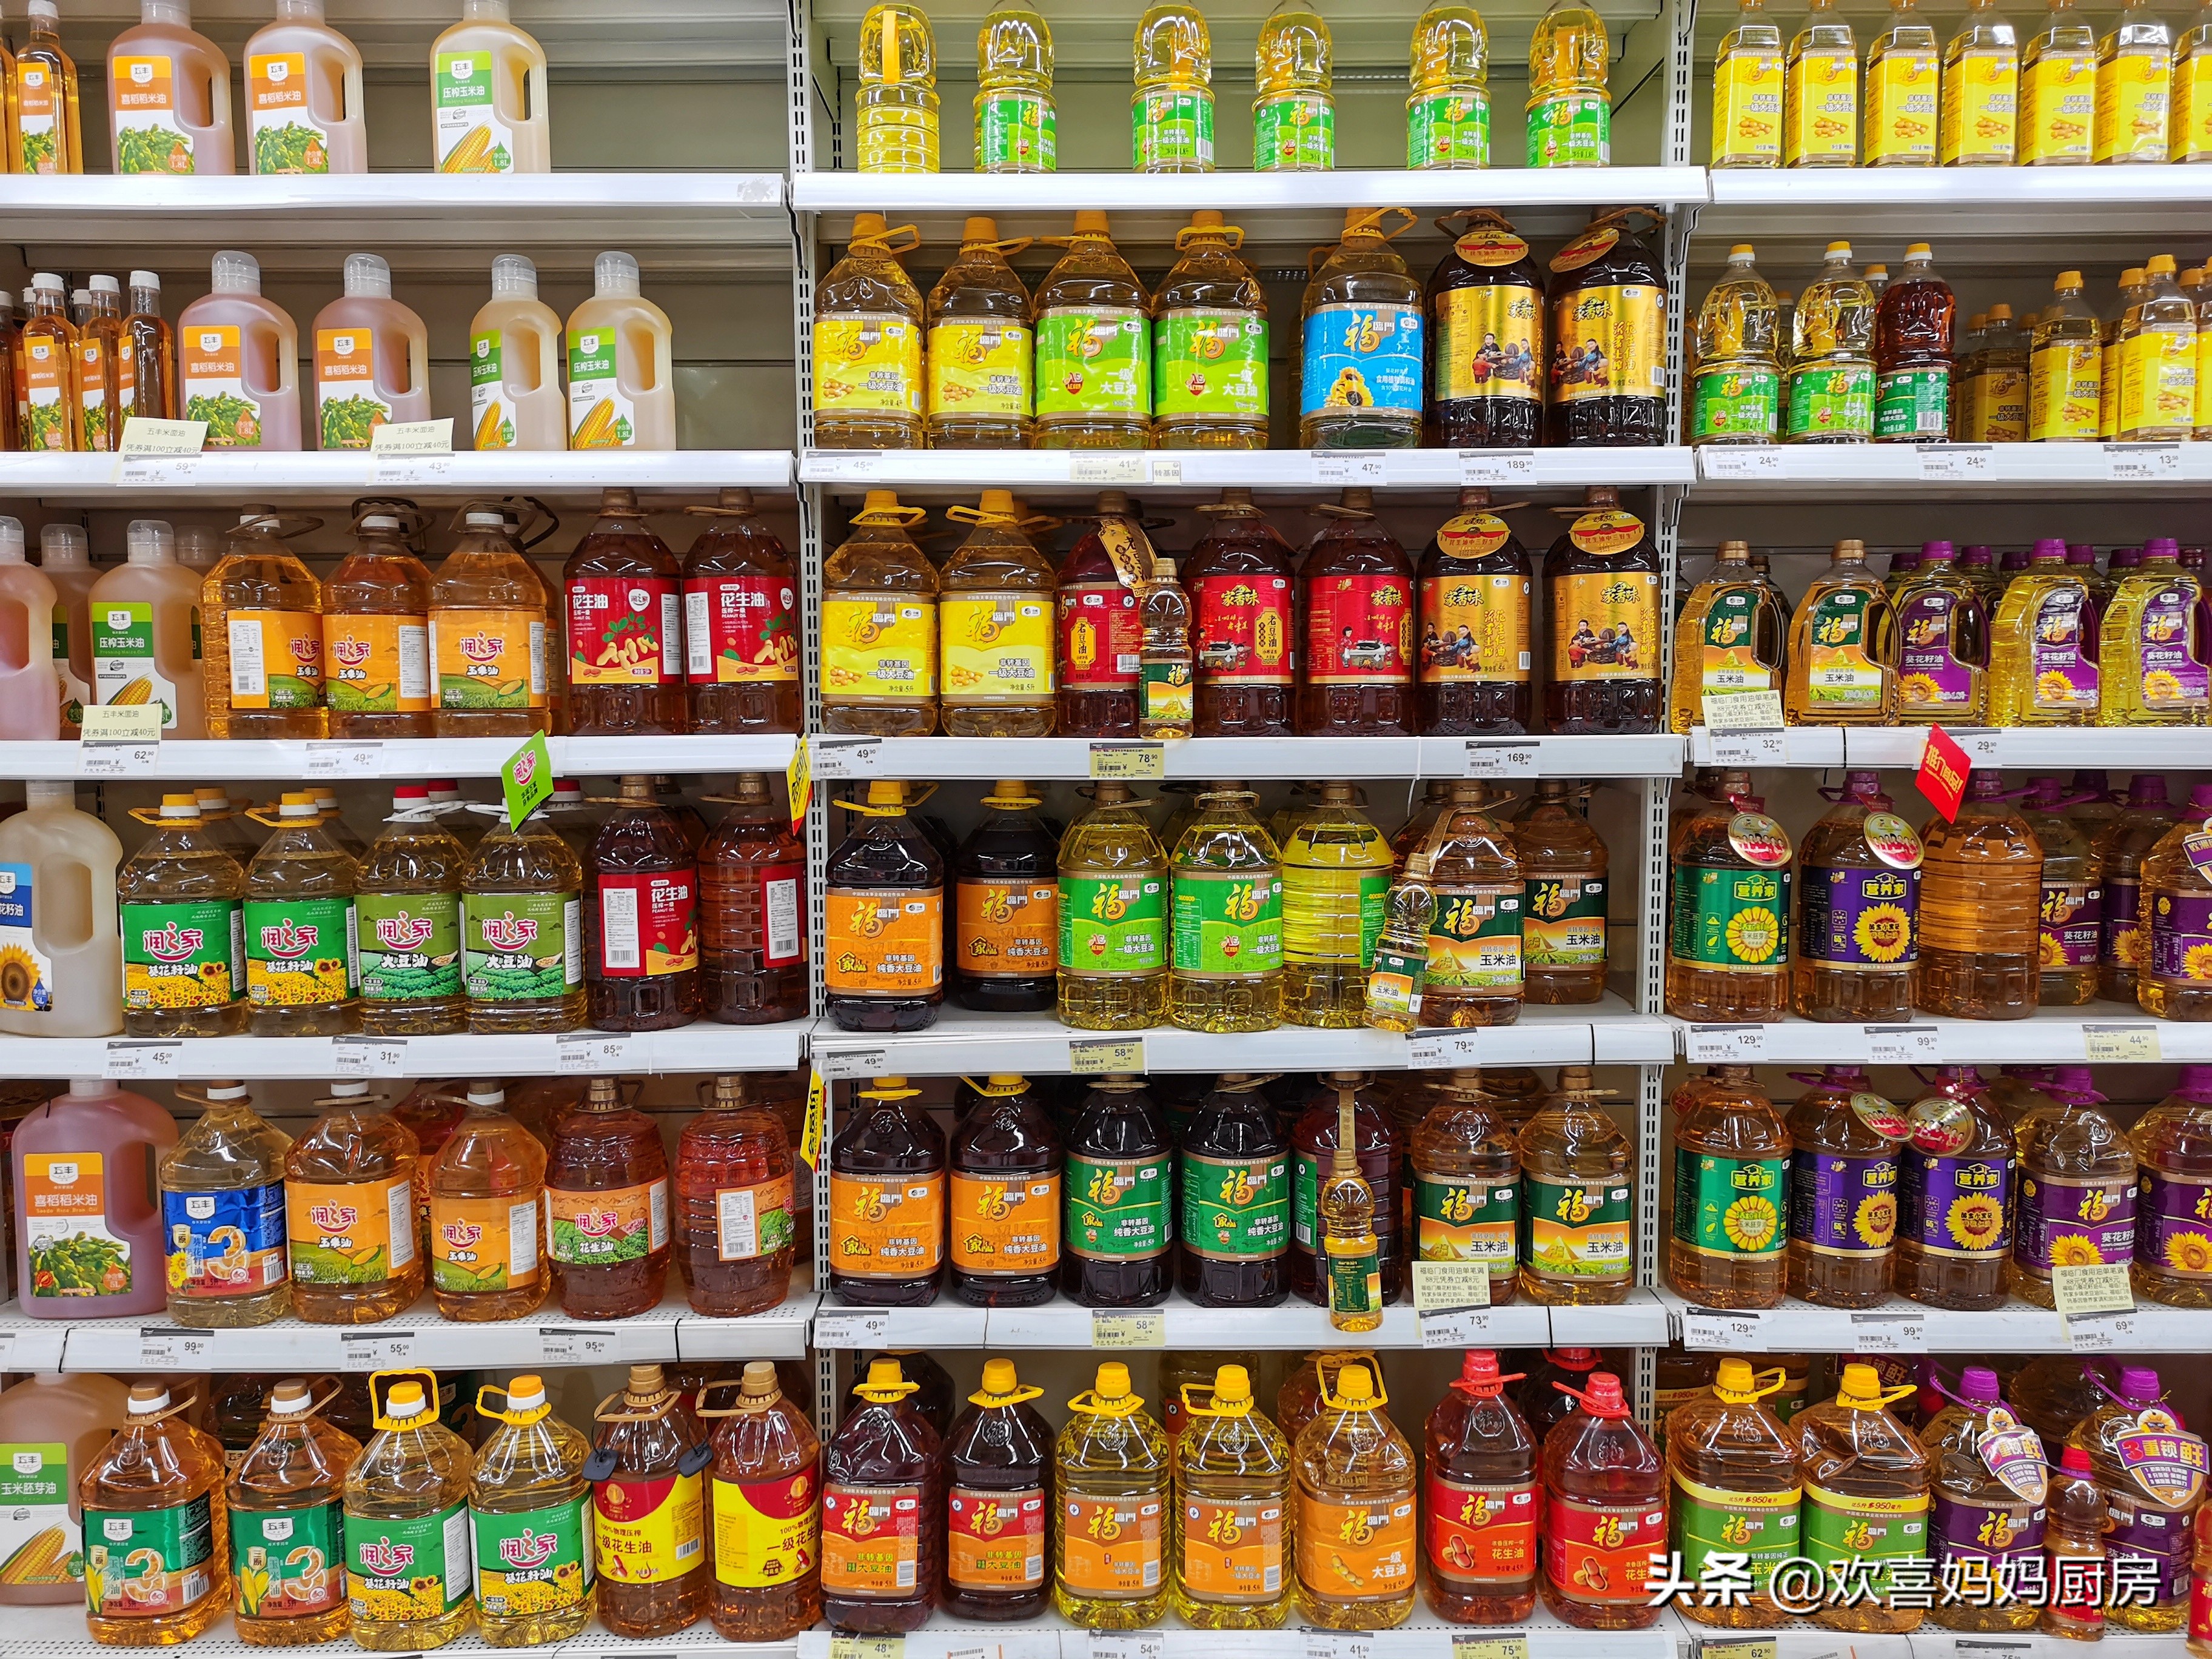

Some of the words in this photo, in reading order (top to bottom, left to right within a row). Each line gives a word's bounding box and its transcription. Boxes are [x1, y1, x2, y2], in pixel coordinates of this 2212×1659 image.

[258, 90, 301, 104] 喜稻稻米油
[443, 85, 485, 98] 压榨玉米油
[120, 93, 167, 108] 喜稻稻米油
[190, 361, 235, 374] 喜稻稻米油
[324, 364, 368, 376] 喜稻稻米油
[574, 360, 610, 374] 压榨玉米油
[869, 371, 899, 380] 非转基因
[989, 375, 1018, 384] 非转基因
[858, 380, 903, 392] 一级大豆油
[980, 383, 1022, 395] 一级大豆油
[1100, 381, 1138, 395] 大豆油
[1222, 383, 1258, 397] 大豆油
[147, 427, 185, 437] 五丰米面油
[238, 427, 255, 435] 1.8L
[396, 426, 435, 435] 五丰米面油
[126, 443, 201, 455] 凭券满100立减40元
[375, 440, 450, 452] 凭券满100立减40元
[1506, 460, 1532, 469] 189.90
[1966, 456, 1986, 464] 24.90
[2159, 455, 2179, 464] 13.50
[572, 593, 609, 610] 花生油
[720, 592, 766, 607] 花生油
[1267, 615, 1278, 648] 老豆油
[99, 637, 145, 649] 压榨玉米油
[1076, 623, 1088, 655] 老豆油
[1905, 654, 1943, 665] 葵花籽油
[2041, 651, 2076, 662] 葵花籽油
[2147, 651, 2183, 661] 葵花籽油
[877, 659, 910, 668] 非转基因
[998, 659, 1030, 668] 非转基因
[338, 668, 367, 680] 玉米油
[466, 665, 500, 677] 玉米油
[867, 669, 914, 680] 一级大豆油
[988, 668, 1036, 679] 一级大豆油
[1716, 673, 1744, 683] 玉米油
[1825, 672, 1854, 683] 玉米油
[102, 709, 139, 719] 五丰米面油
[82, 728, 156, 737] 凭券满100立减40元
[1763, 739, 1782, 748] 32.90
[1977, 742, 1997, 750] 29.90
[135, 751, 154, 759] 62.90
[857, 749, 876, 758] 49.90
[1138, 754, 1158, 762] 78.90
[1507, 754, 1532, 762] 169.90
[650, 885, 688, 902] 花生油
[1737, 884, 1775, 899] 营养家
[1865, 882, 1905, 896] 营养家
[377, 910, 433, 941] 润之家
[482, 910, 538, 941] 润之家
[1124, 934, 1153, 943] 非转基因
[1566, 933, 1601, 946] 玉米油
[2063, 930, 2097, 940] 葵花籽油
[1006, 946, 1050, 956] 纯香大豆油
[1114, 943, 1155, 954] 一级大豆油
[1248, 943, 1279, 955] 一级大豆油
[381, 953, 429, 970] 大豆油
[487, 953, 535, 970] 大豆油
[885, 953, 915, 963] 非转基因
[1480, 953, 1517, 967] 玉米油
[148, 963, 198, 977] 葵花籽油
[266, 959, 313, 973] 葵花籽油
[876, 962, 922, 974] 纯香大豆油
[1375, 985, 1399, 997] 玉米油
[1737, 1036, 1763, 1044] 129.00
[1917, 1036, 1937, 1045] 99.90
[2130, 1035, 2149, 1044] 44.90
[603, 1045, 622, 1053] 85.00
[1455, 1041, 1474, 1050] 79.90
[152, 1052, 172, 1061] 45.00
[380, 1051, 400, 1060] 31.90
[1958, 1173, 1999, 1185] 营养家
[33, 1192, 98, 1208] 喜稻稻米油
[1121, 1216, 1149, 1226] 非转基因
[1253, 1215, 1280, 1226] 非转基因
[1113, 1225, 1155, 1236] 纯香大豆油
[1247, 1222, 1284, 1236] 纯香大豆油
[318, 1236, 353, 1248] 玉米油
[1011, 1235, 1041, 1243] 非转基因
[2100, 1231, 2134, 1242] 葵花籽油
[579, 1241, 615, 1254] 花生油
[879, 1245, 925, 1257] 纯香大豆油
[1004, 1242, 1048, 1255] 纯香大豆油
[1470, 1239, 1509, 1253] 玉米油
[1587, 1241, 1624, 1254] 玉米油
[447, 1250, 477, 1261] 玉米油
[865, 1321, 885, 1330] 49.90
[1136, 1320, 1155, 1329] 58.90
[1470, 1315, 1489, 1325] 73.90
[2115, 1321, 2134, 1330] 69.90
[1731, 1323, 1756, 1333] 129.00
[1903, 1326, 1923, 1336] 99.90
[184, 1342, 204, 1350] 99.00
[390, 1344, 409, 1353] 55.00
[585, 1341, 605, 1350] 95.00
[1, 1481, 57, 1496] 玉米胚芽油
[597, 1534, 652, 1554] 一级花生油
[856, 1552, 895, 1562] 非转基因
[985, 1550, 1023, 1560] 非转基因
[1378, 1551, 1402, 1564] 一级
[1492, 1546, 1525, 1560] 花生油
[857, 1561, 893, 1574] 大豆油
[987, 1560, 1022, 1572] 大豆油
[1372, 1563, 1407, 1578] 大豆油
[504, 1569, 554, 1584] 葵花籽油
[364, 1577, 409, 1591] 葵花籽油
[874, 1642, 895, 1652] 48.90
[1141, 1644, 1160, 1654] 54.90
[1349, 1643, 1370, 1655] 41.50
[1501, 1645, 1521, 1655] 75.50
[1751, 1647, 1771, 1658] 62.90
